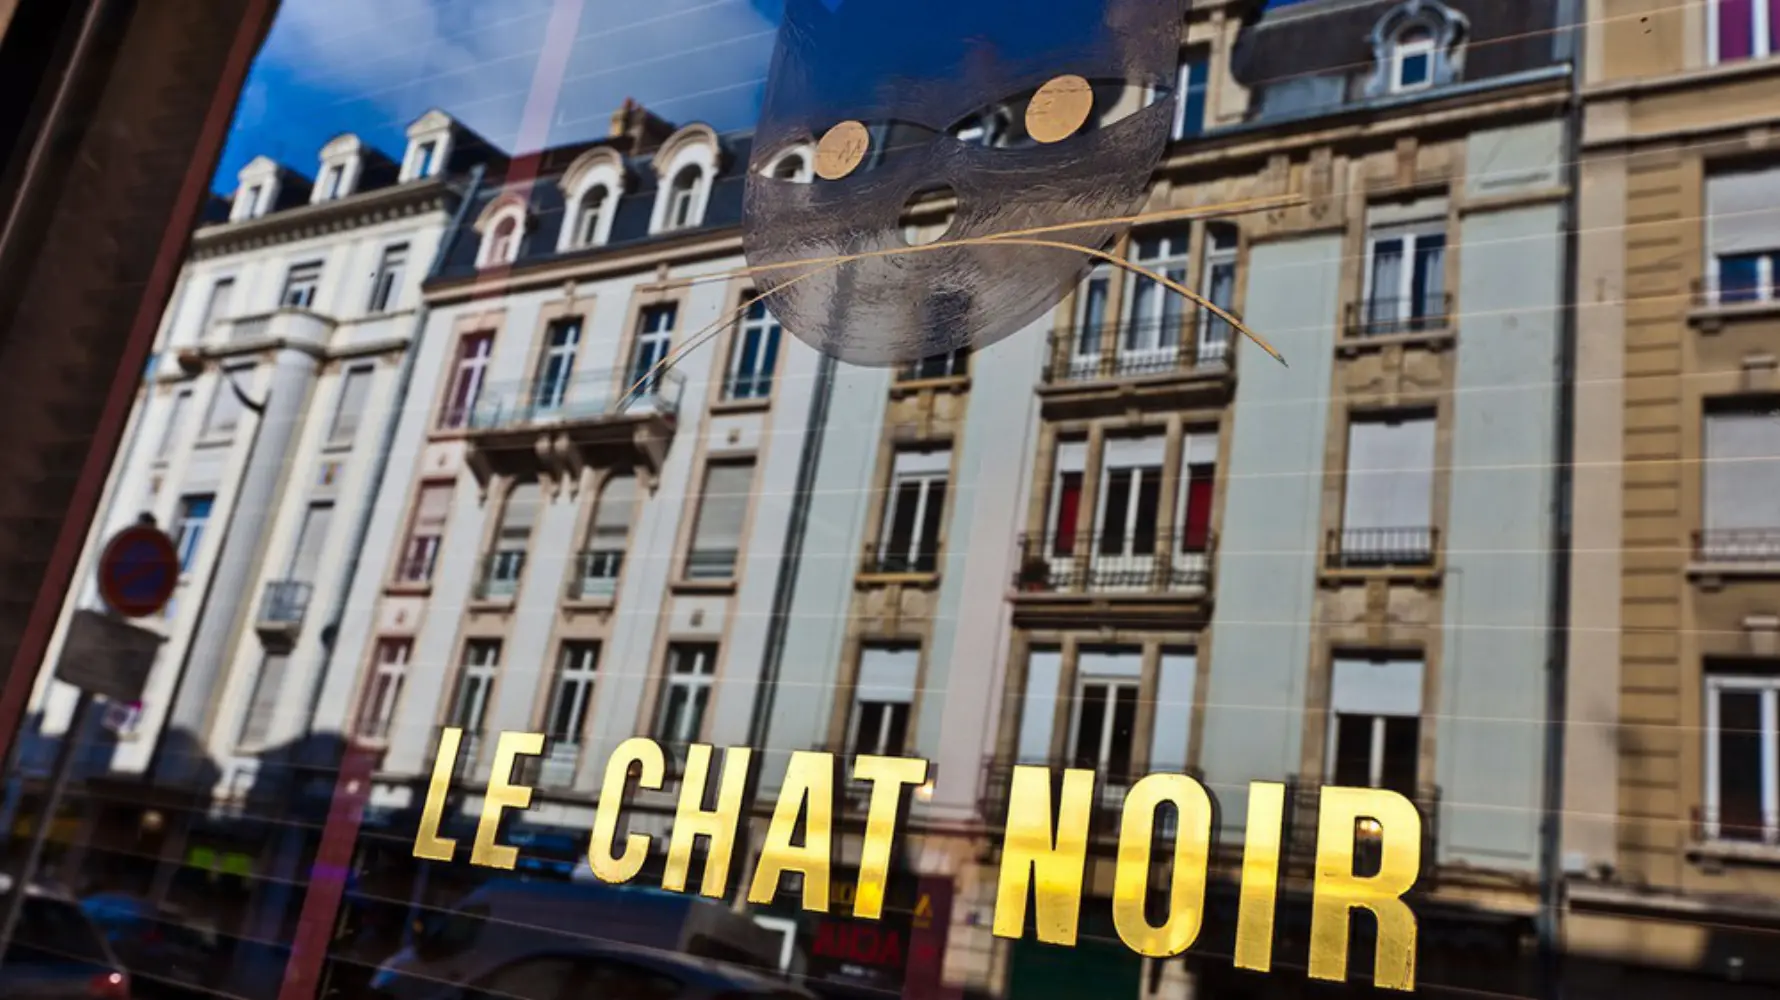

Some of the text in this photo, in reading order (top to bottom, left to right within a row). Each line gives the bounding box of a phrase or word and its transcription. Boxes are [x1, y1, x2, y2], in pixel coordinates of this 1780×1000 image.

[413, 727, 1421, 992] LE CHAT NOIR
